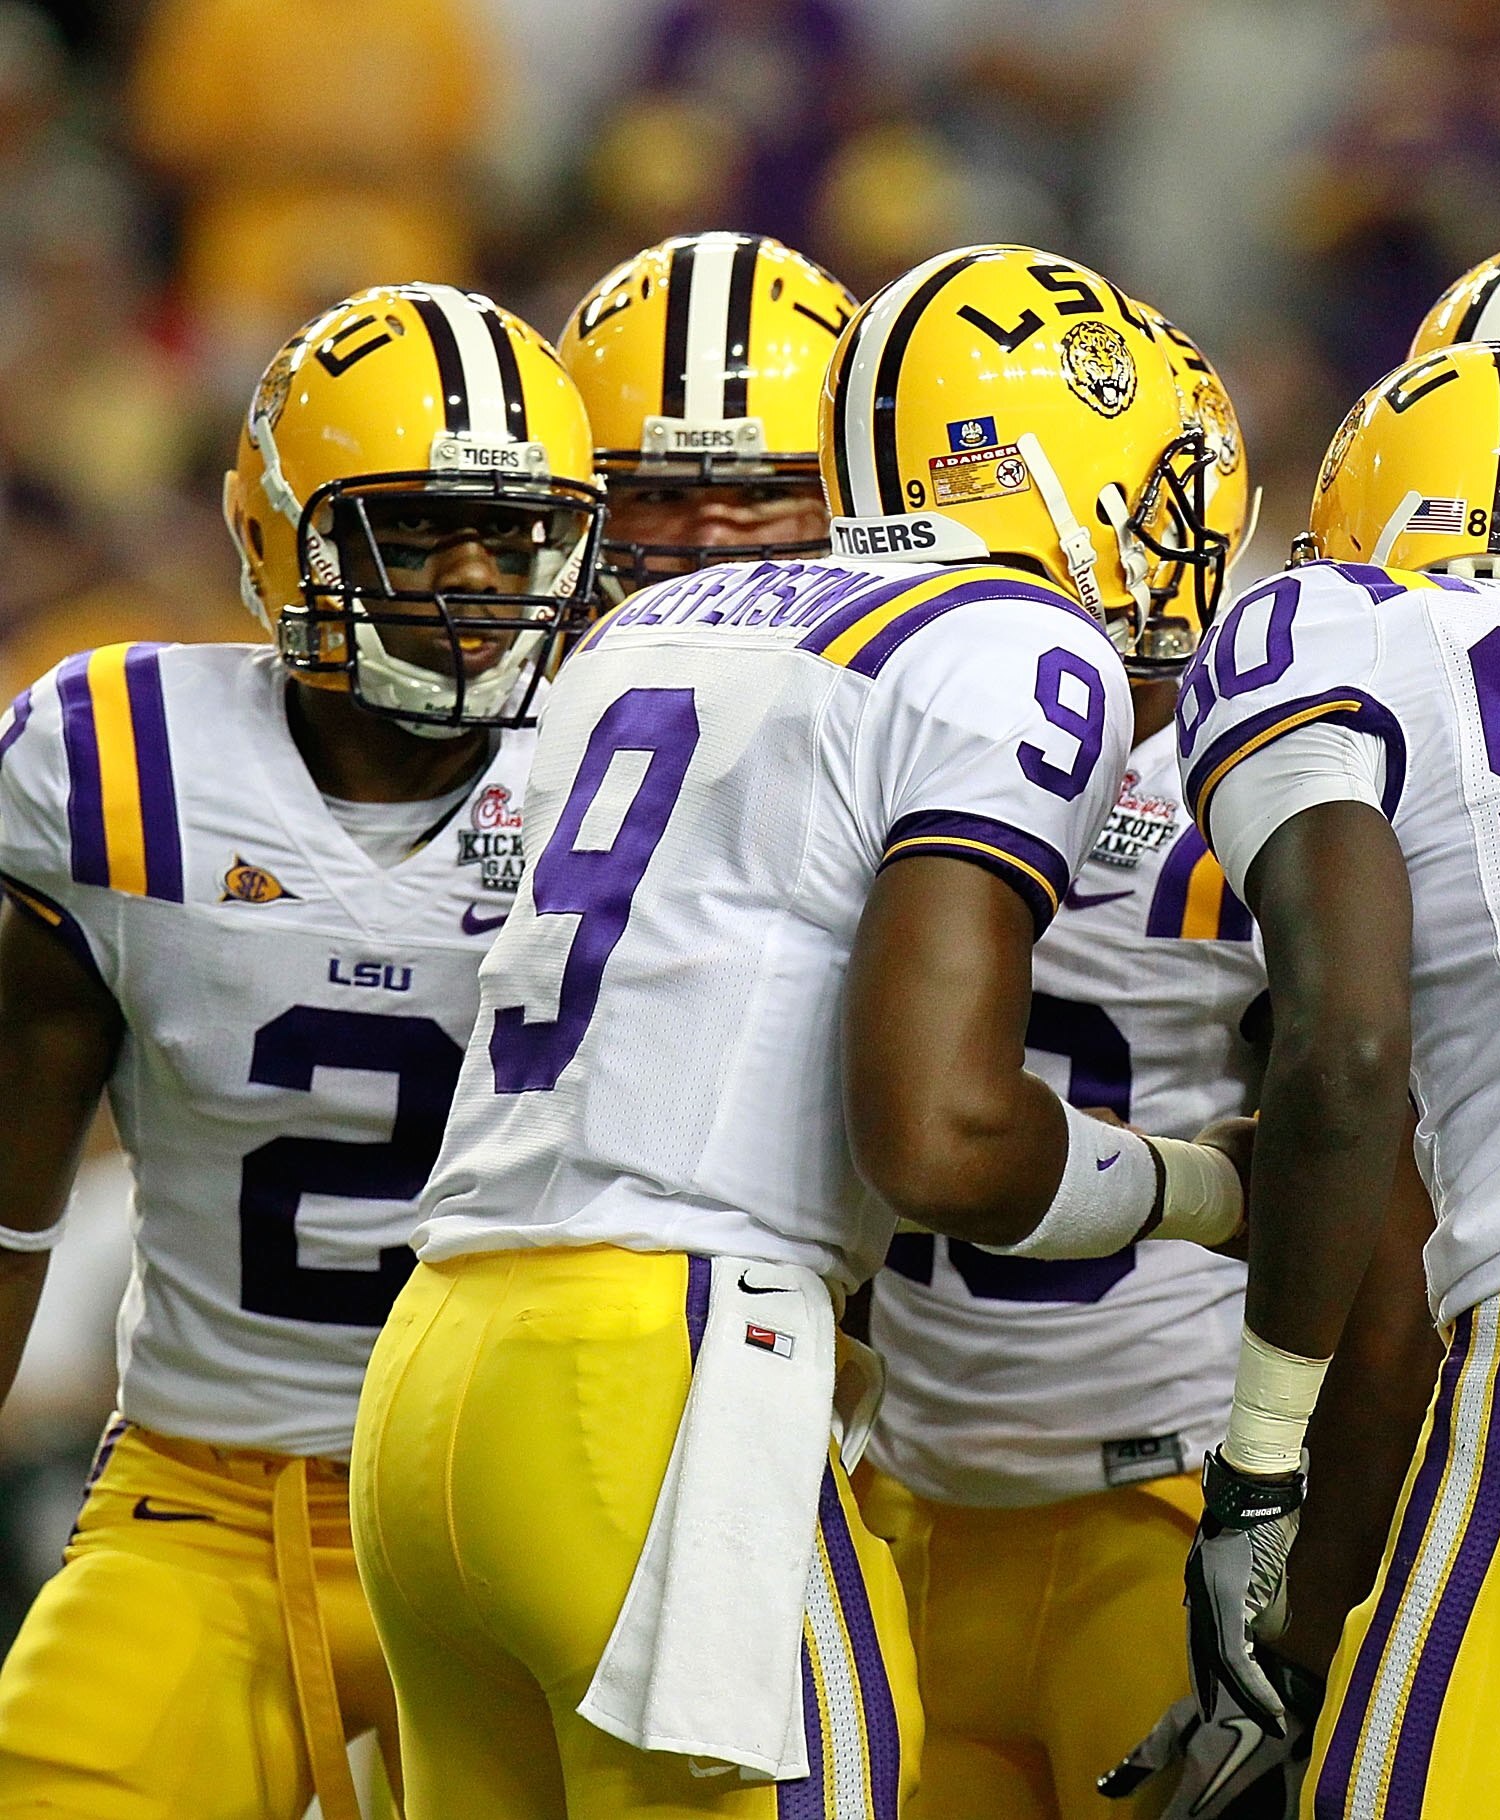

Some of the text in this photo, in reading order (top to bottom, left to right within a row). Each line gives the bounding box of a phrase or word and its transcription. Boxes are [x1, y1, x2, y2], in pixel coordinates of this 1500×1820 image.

[675, 430, 734, 448] TIGERS
[946, 446, 1018, 466] DANGER
[463, 447, 520, 468] TIGERS
[906, 479, 926, 509] 9
[835, 520, 937, 555] TIGERS
[1467, 508, 1488, 537] 8
[616, 561, 884, 629] JEFFERSON
[1175, 575, 1302, 759] 80
[1015, 645, 1107, 802] 9
[488, 686, 701, 1095] 9
[327, 957, 412, 994] LSU
[240, 1004, 468, 1329] 2
